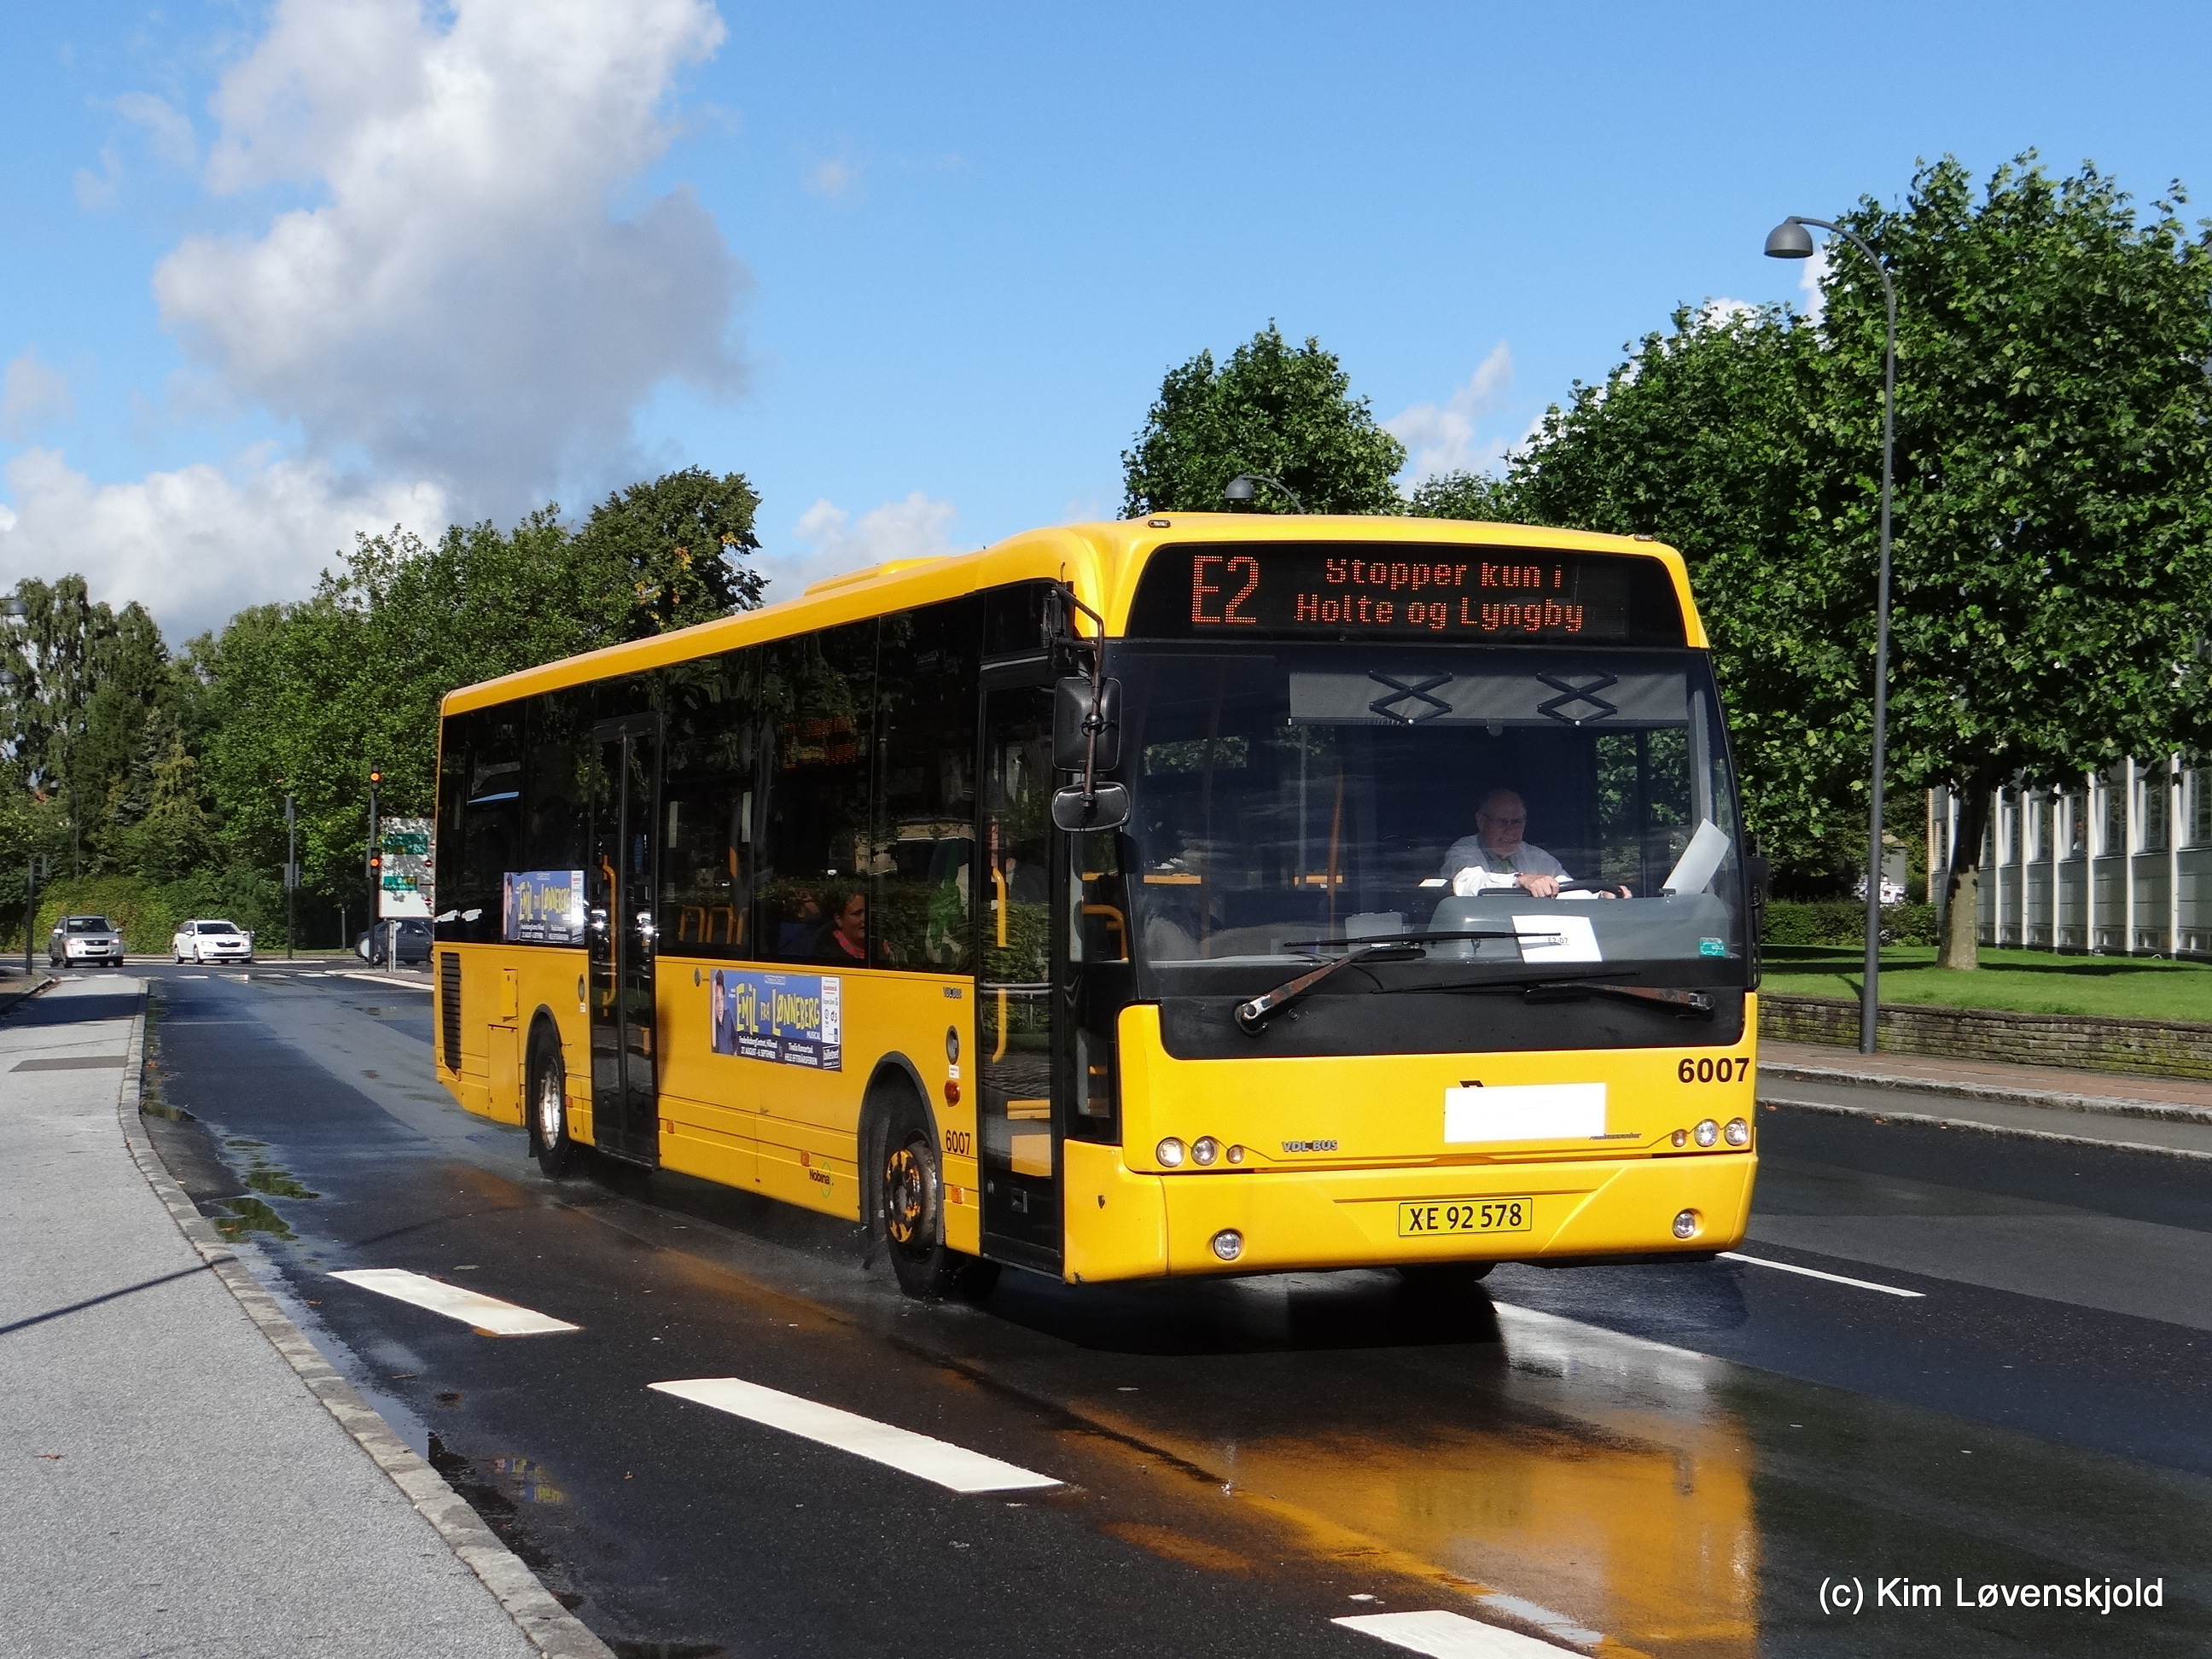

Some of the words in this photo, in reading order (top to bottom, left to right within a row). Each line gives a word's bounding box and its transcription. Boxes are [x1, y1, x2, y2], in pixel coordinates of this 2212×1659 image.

[1325, 558, 1468, 591] Stopper
[1481, 562, 1541, 588] kun
[1553, 564, 1563, 589] i
[1191, 555, 1260, 625] E2
[1295, 593, 1394, 624] Holte
[1407, 600, 1448, 630] og
[1460, 597, 1585, 632] Lyngby
[736, 982, 759, 1035] EMIL
[771, 988, 821, 1037] LØNNEBERG
[1678, 1057, 1750, 1083] 6007
[946, 1129, 971, 1155] 6007
[1281, 1141, 1309, 1152] VDL
[1312, 1139, 1338, 1152] BUS
[1409, 1208, 1439, 1231] XE
[1447, 1206, 1474, 1230] 92
[1481, 1203, 1522, 1228] 578
